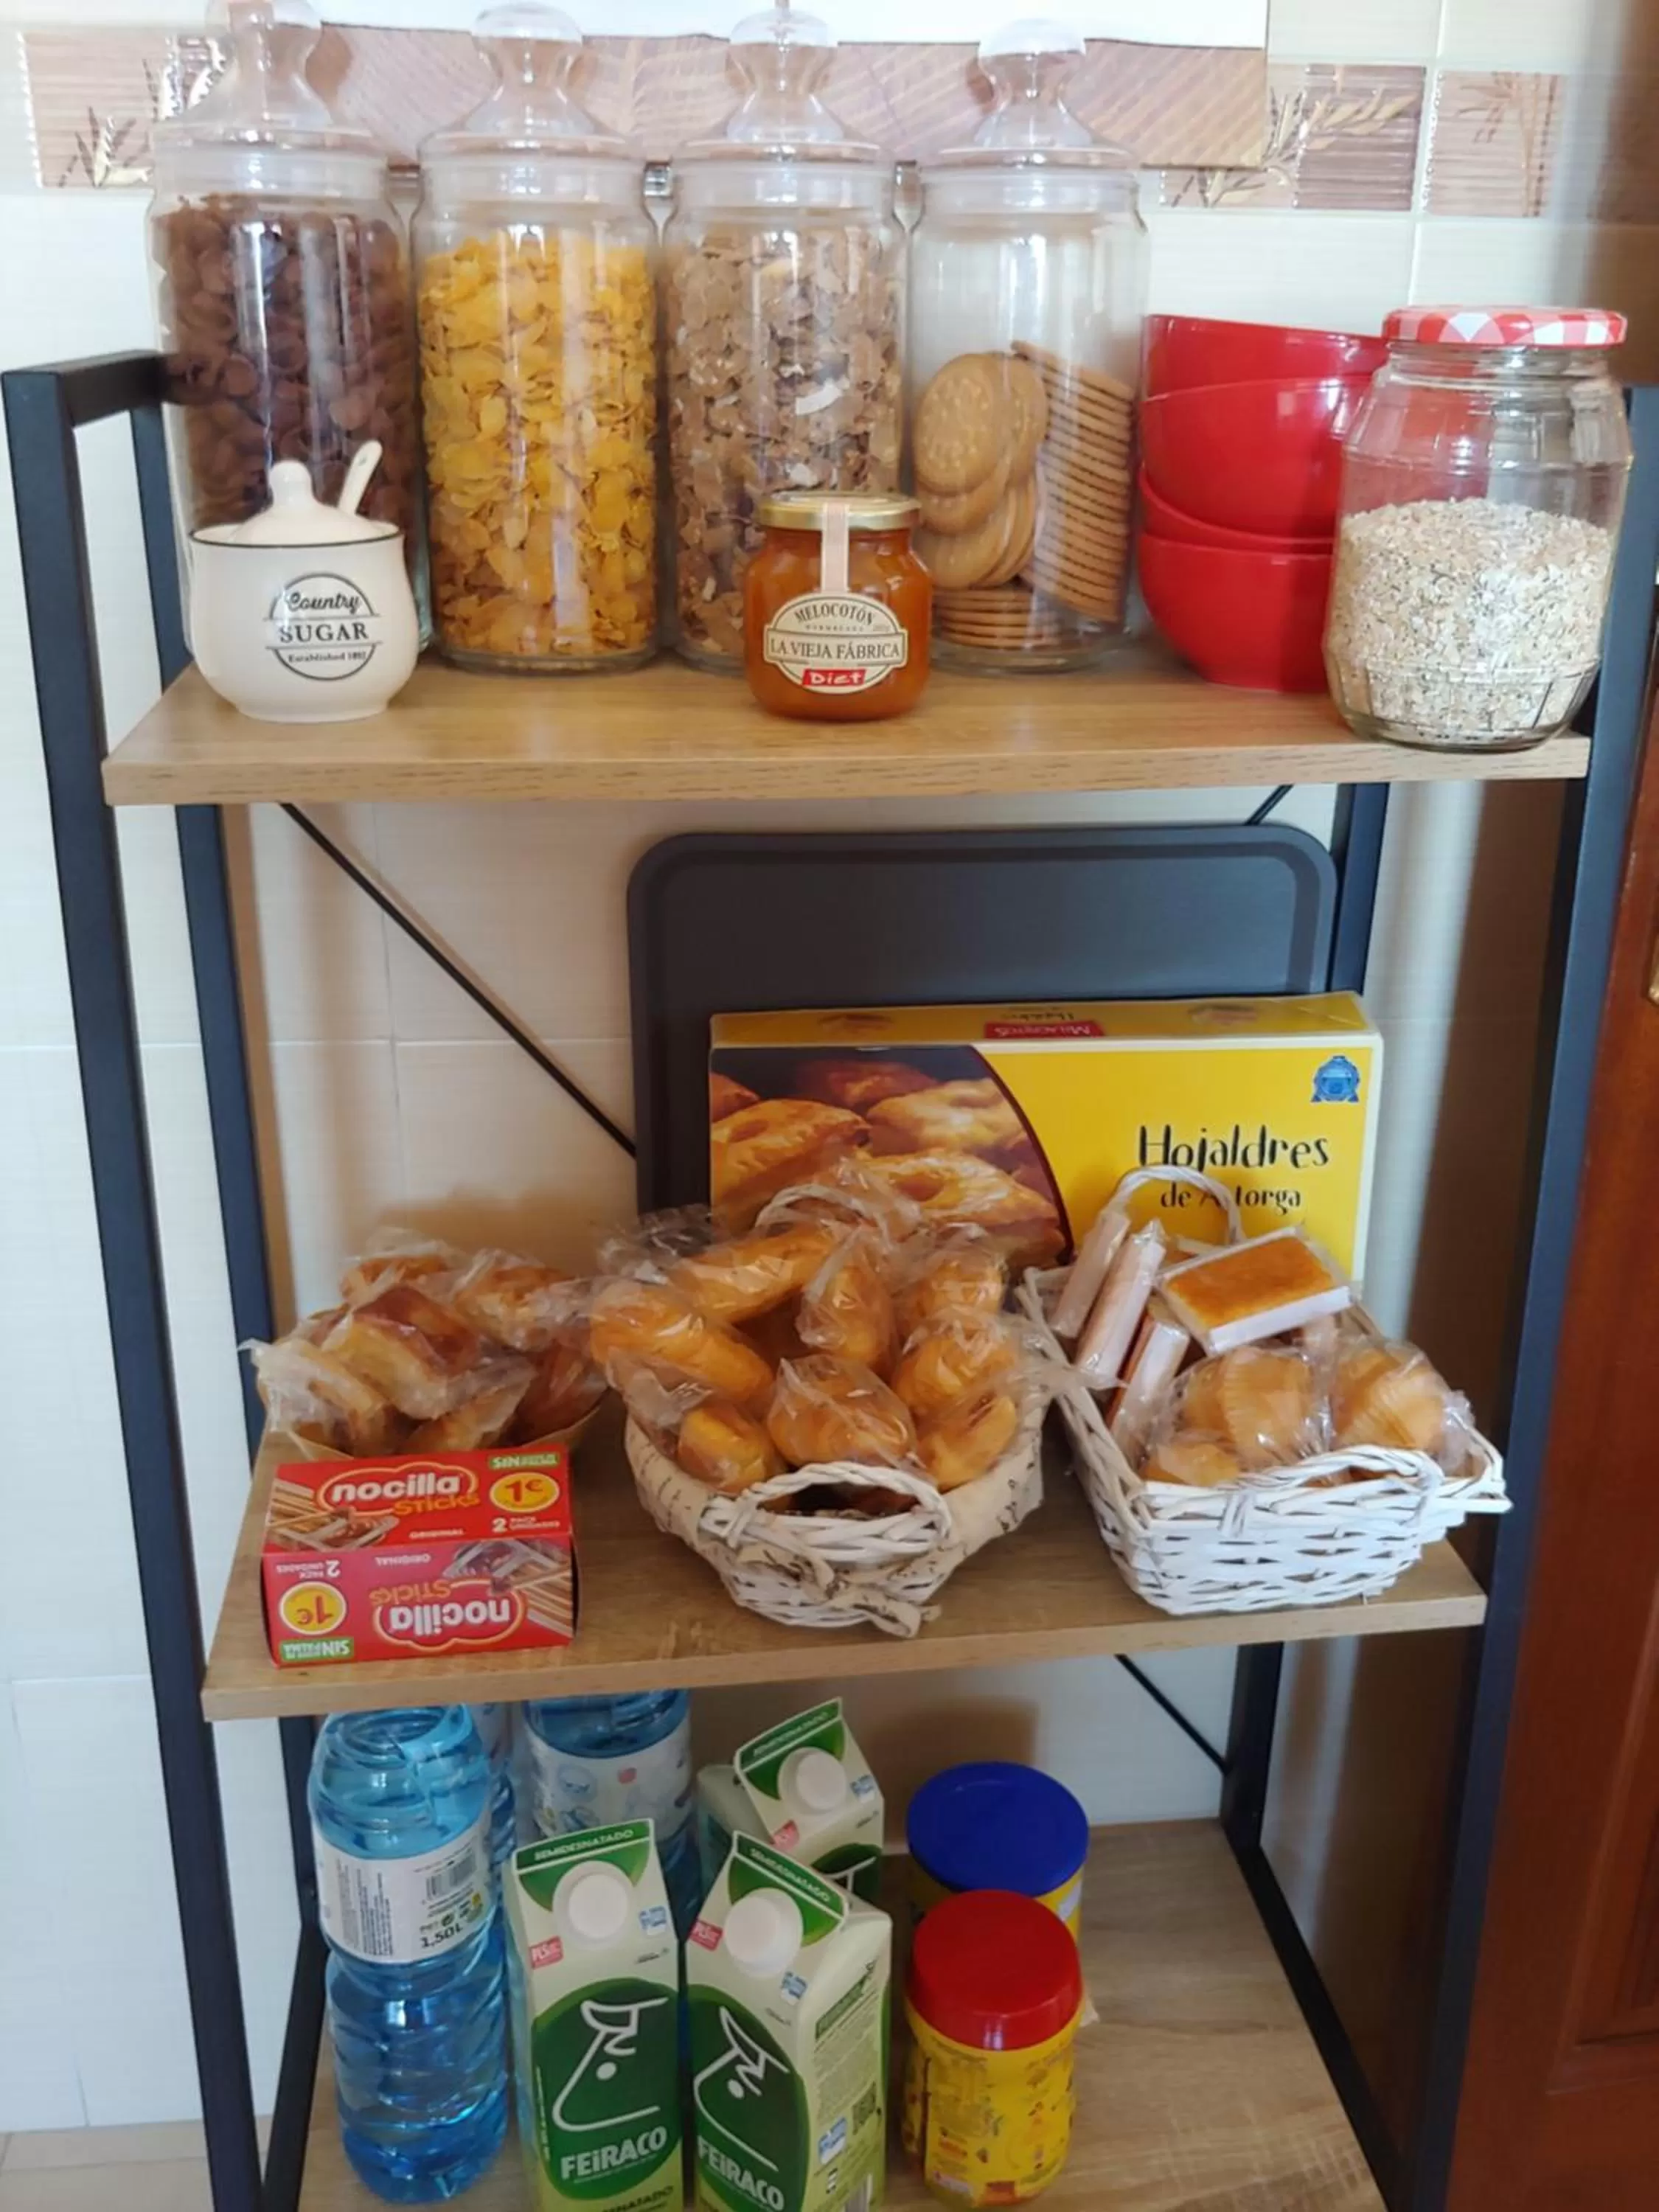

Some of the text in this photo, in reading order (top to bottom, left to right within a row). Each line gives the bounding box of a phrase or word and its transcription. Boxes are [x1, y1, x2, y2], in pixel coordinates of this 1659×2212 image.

[288, 591, 360, 615] Country
[794, 603, 874, 625] MELOCOTÓN
[279, 622, 369, 643] SUGAR
[771, 637, 900, 660] LA VIEJA FÁBRICA
[810, 671, 863, 684] Diet
[1139, 1124, 1329, 1172] Hojaldres
[1161, 1181, 1301, 1216] de Atorga
[332, 1472, 461, 1503] nocilla
[492, 1517, 508, 1534] 2
[326, 1559, 341, 1578] 2
[389, 1599, 510, 1636] nocilla
[321, 1639, 350, 1656] SIN
